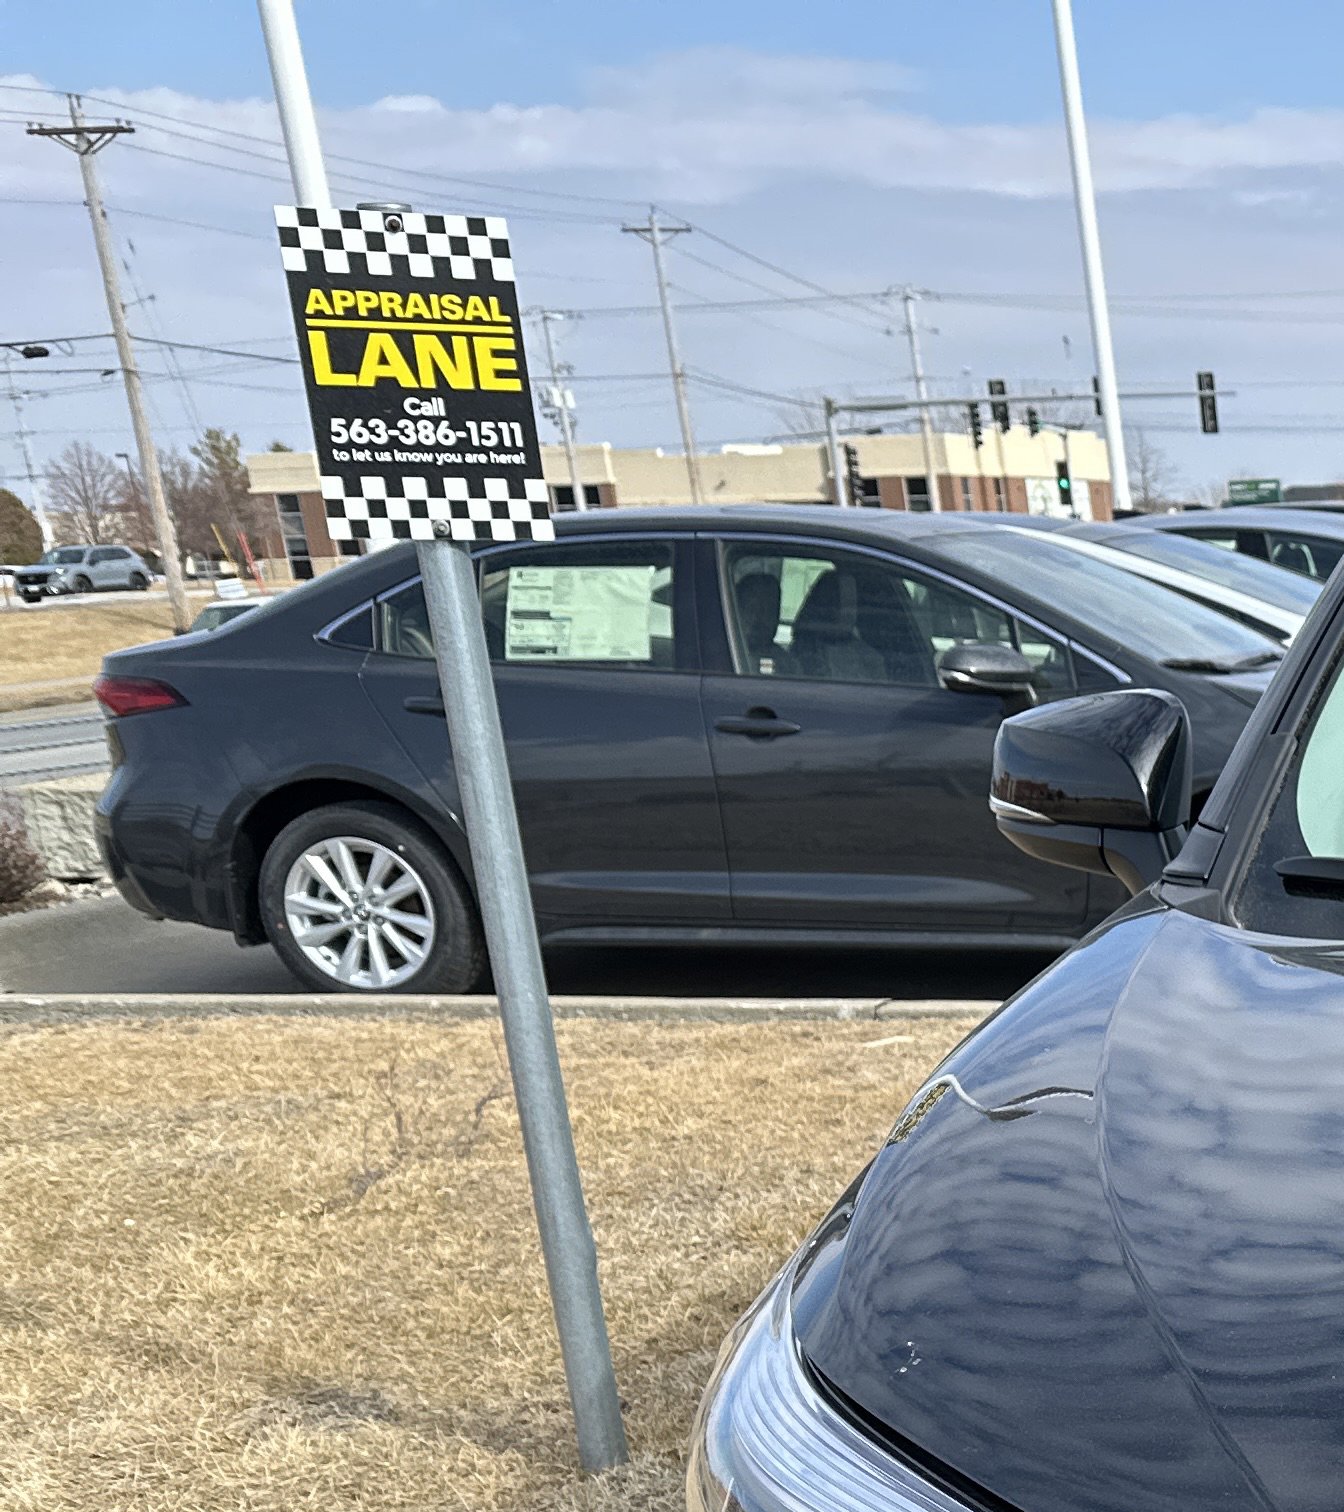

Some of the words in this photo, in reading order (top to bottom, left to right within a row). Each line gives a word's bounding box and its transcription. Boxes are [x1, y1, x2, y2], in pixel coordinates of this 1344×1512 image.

[306, 289, 512, 323] APPRAISAL
[307, 330, 522, 391] LANE
[403, 396, 446, 416] Call
[330, 417, 524, 447] 563-386-1511
[332, 448, 350, 462] to
[352, 448, 373, 462] let
[374, 451, 393, 462] us
[394, 449, 435, 463] know
[435, 452, 463, 466] you
[465, 453, 489, 463] are
[489, 451, 526, 465] here!
